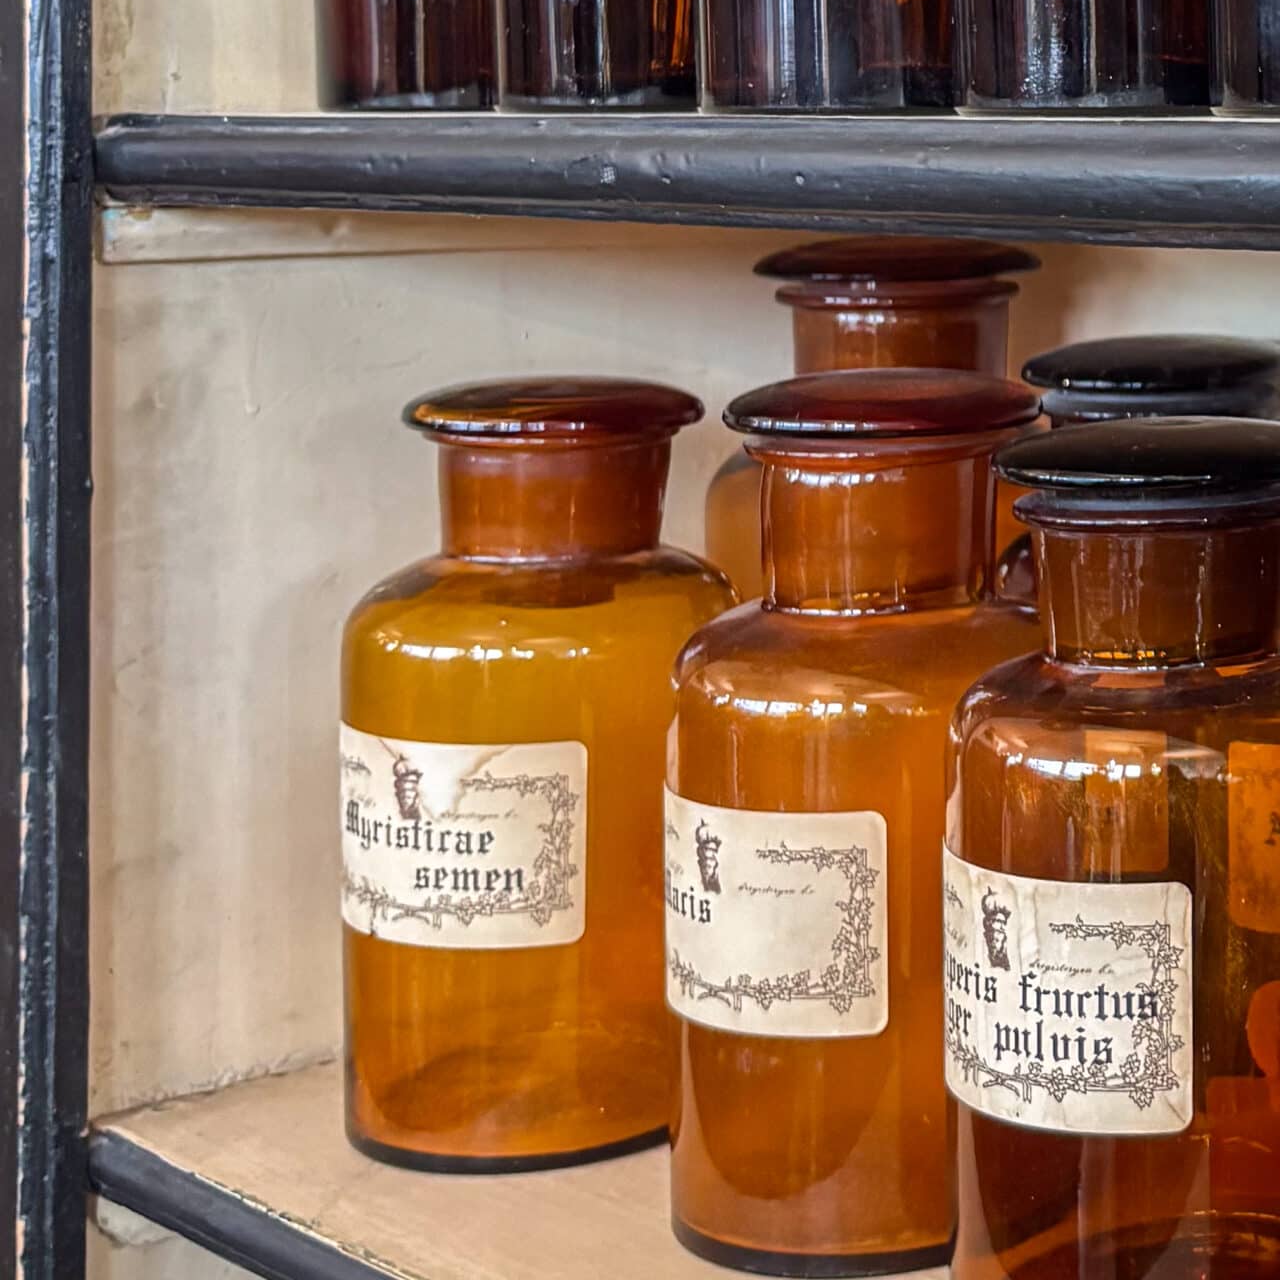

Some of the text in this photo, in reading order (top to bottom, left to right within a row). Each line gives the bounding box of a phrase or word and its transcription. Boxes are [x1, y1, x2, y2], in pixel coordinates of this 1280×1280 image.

[345, 799, 495, 854] Myristicae
[414, 866, 524, 893] semen
[1018, 971, 1159, 1021] fructus
[993, 1020, 1114, 1066] pulvis
